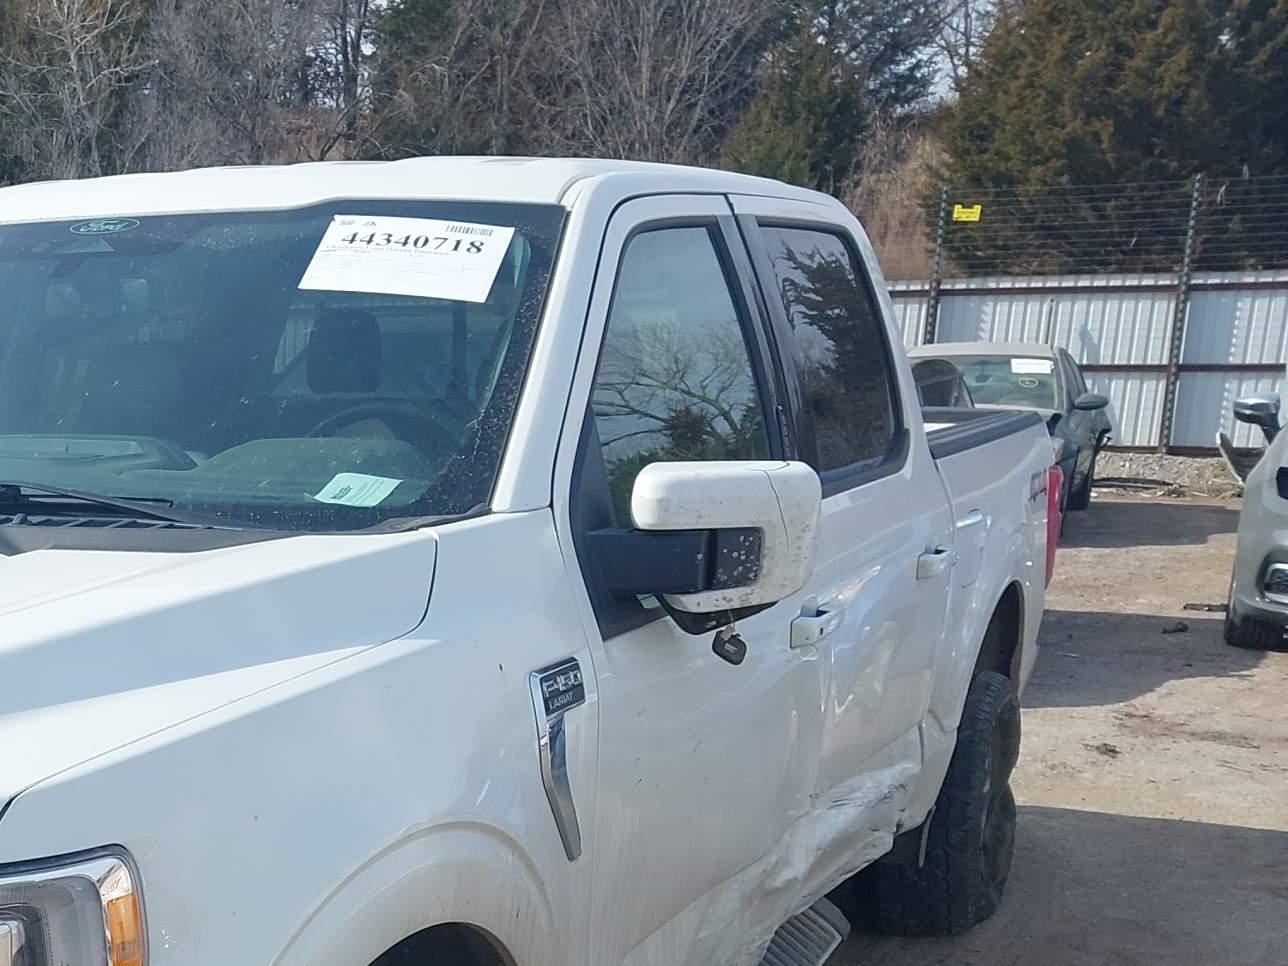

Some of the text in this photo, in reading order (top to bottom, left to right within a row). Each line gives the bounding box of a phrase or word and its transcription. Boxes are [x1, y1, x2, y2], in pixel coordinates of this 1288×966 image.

[79, 219, 129, 232] Ford
[341, 231, 485, 254] 44340718
[549, 692, 574, 710] LARIAT
